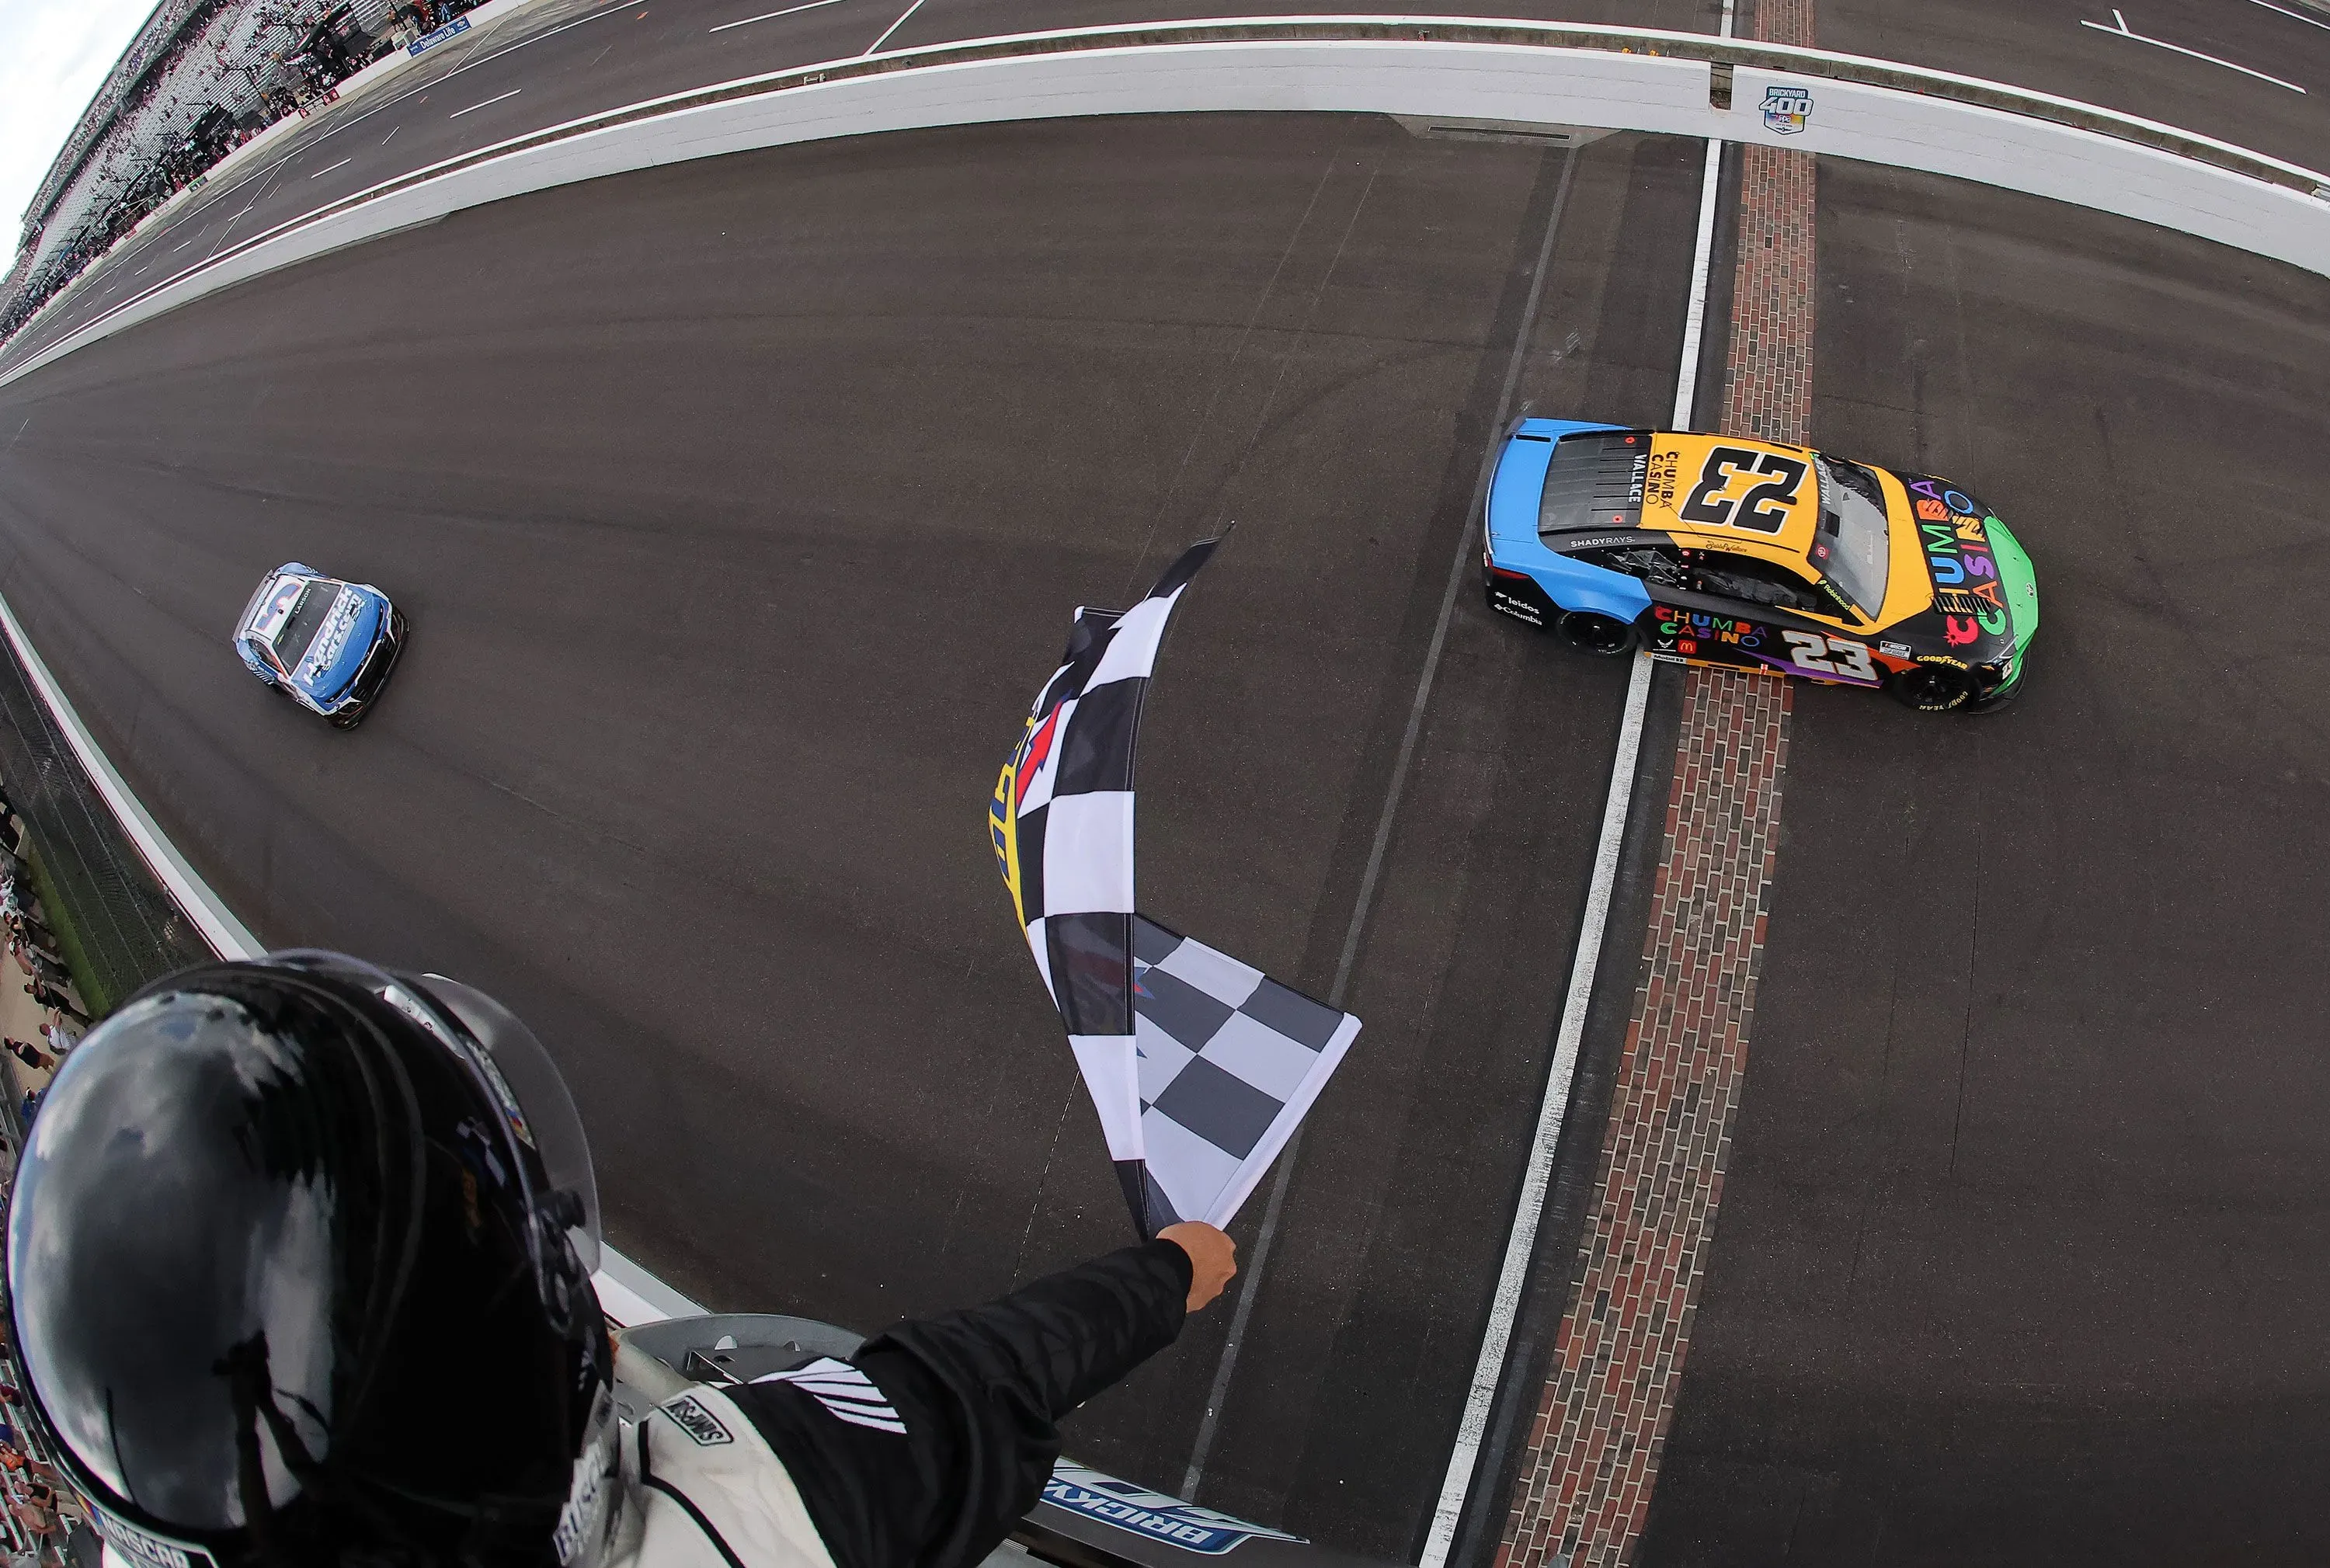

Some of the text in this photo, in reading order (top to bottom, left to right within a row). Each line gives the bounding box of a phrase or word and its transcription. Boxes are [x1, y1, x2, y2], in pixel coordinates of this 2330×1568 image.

[421, 33, 443, 49] Delaware
[443, 26, 455, 40] Life
[1759, 97, 1813, 115] 400
[1769, 89, 1806, 98] BRICKYARD
[1628, 454, 1647, 503] WALLACE
[1646, 454, 1664, 505] CASINO
[1660, 451, 1679, 509] CHUMBA
[1678, 445, 1810, 536] 23
[1817, 457, 1831, 505] WALLACE
[1909, 480, 1978, 648] CHUMBA
[1943, 490, 2006, 635] CASINO
[256, 583, 301, 631] 5
[294, 588, 312, 614] LARSON
[1508, 597, 1539, 614] leidos
[1824, 583, 1852, 611] Robinhood
[1503, 607, 1542, 625] Columbia
[1655, 606, 1768, 638] CHUMBA
[1661, 622, 1760, 647] CASINO
[1782, 630, 1878, 681] 23
[1917, 655, 1968, 670] GOODYEAR
